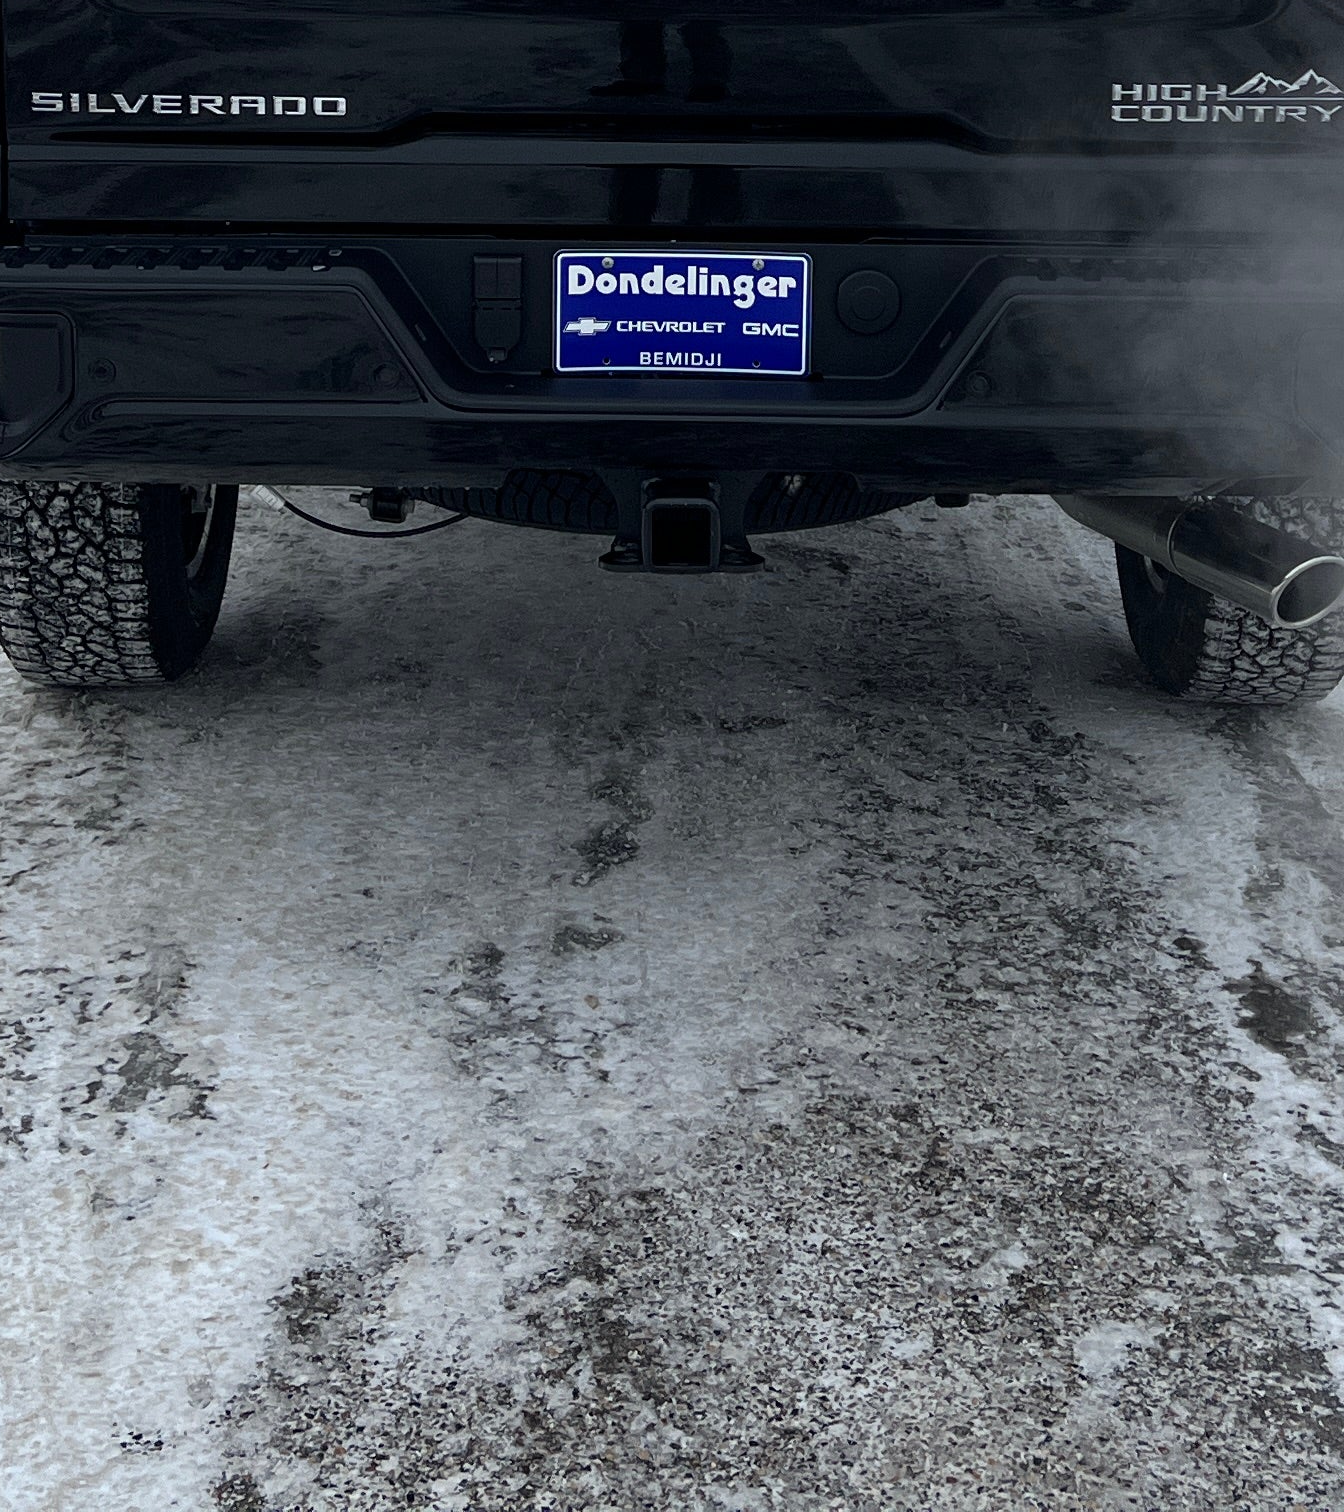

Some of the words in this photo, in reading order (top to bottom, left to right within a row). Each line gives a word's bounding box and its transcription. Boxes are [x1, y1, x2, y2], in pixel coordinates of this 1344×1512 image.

[1111, 83, 1229, 102] HIGH
[31, 91, 348, 116] SILVERADO
[1111, 105, 1343, 123] COUNTRY
[567, 264, 798, 309] Dondelinger
[615, 320, 727, 334] CHEVROLET
[741, 322, 800, 338] GMC
[639, 351, 723, 367] BEMIDJI
